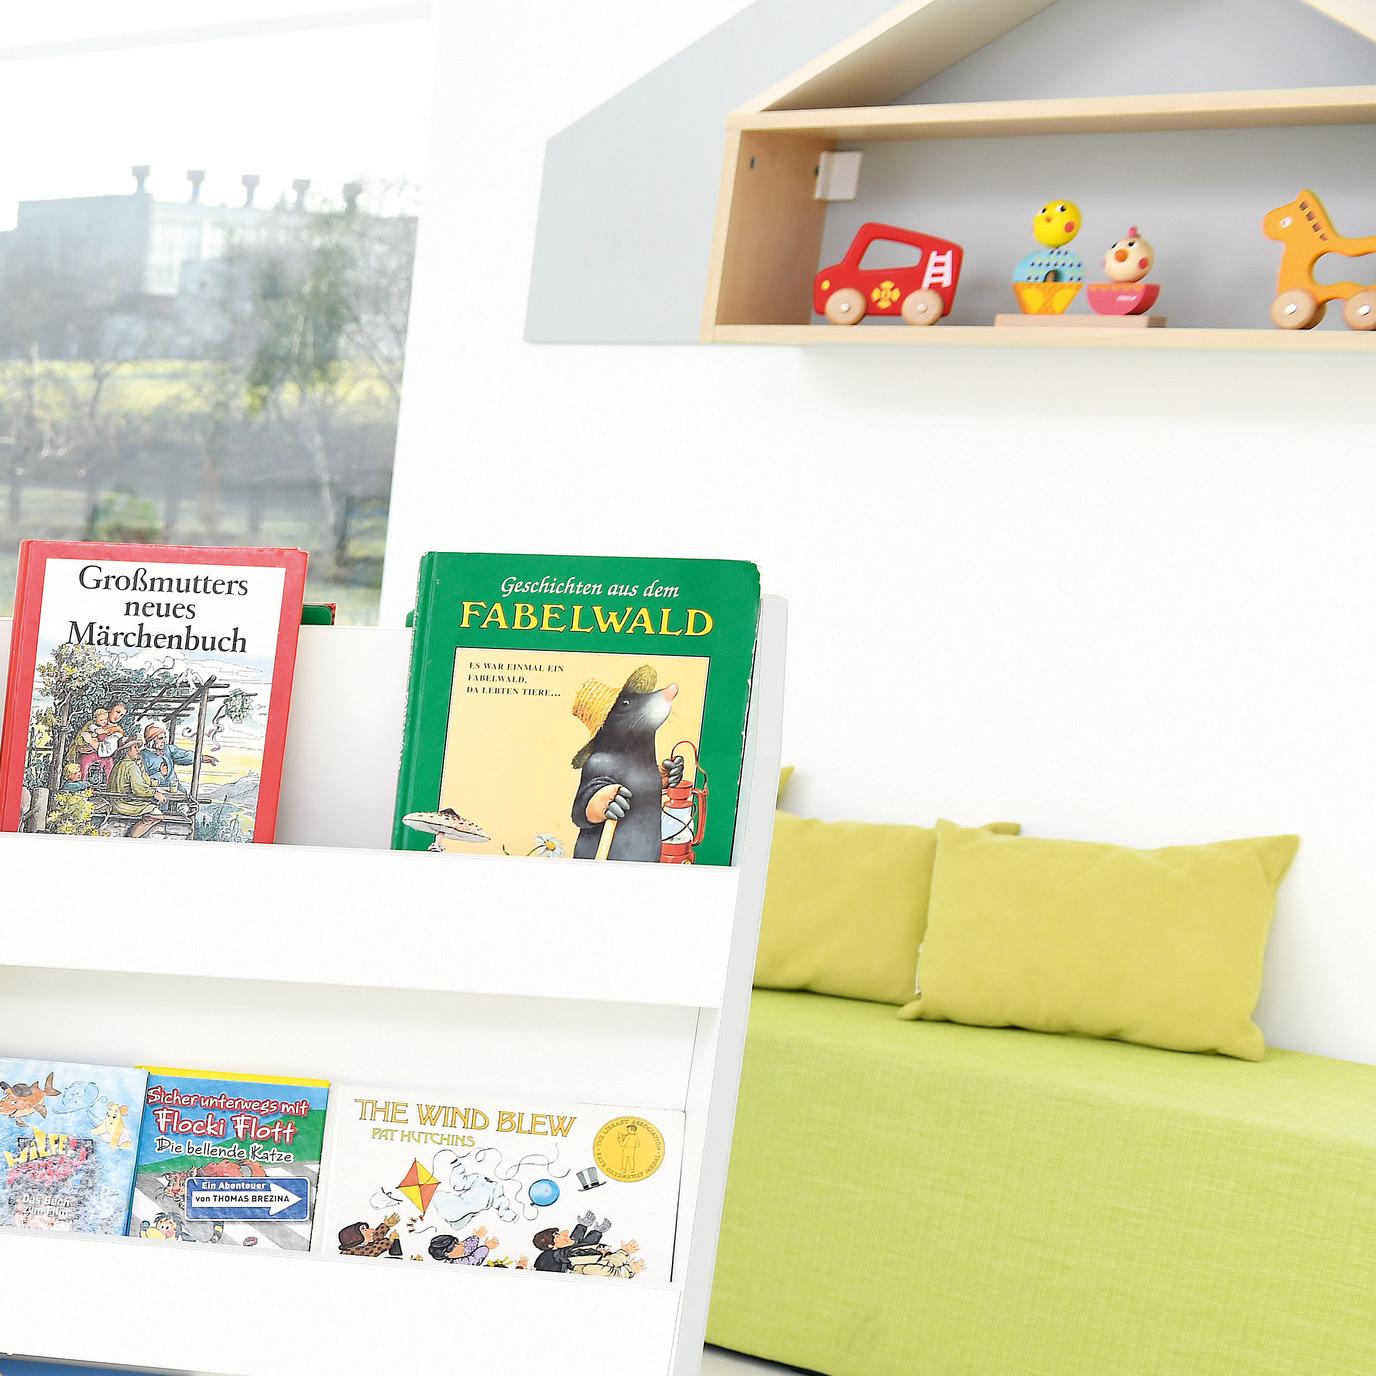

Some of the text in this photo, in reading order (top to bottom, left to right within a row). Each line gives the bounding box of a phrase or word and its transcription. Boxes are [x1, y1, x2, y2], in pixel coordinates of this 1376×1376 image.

[78, 564, 248, 596] Großmutters
[500, 576, 680, 598] Geschichten aus dem
[123, 600, 196, 619] neues
[458, 601, 714, 637] FABELWALD
[66, 620, 247, 653] Märchenbuch
[469, 662, 480, 670] ES
[484, 662, 504, 671] WAR
[507, 663, 545, 672] EINMAL
[466, 686, 479, 694] DA
[482, 687, 519, 696] LEBTEN
[148, 1086, 309, 1116] Sicher unterwegs mit
[153, 1108, 296, 1143] Flocki Flott
[354, 1098, 577, 1137] THE WIND BLEW
[156, 1136, 292, 1163] Die bellende Katze
[371, 1127, 476, 1148] PAT HUTCHINS
[201, 1182, 267, 1190] Ein Abenteuer
[213, 1195, 249, 1203] THOMAS
[252, 1195, 290, 1203] BREZINA
